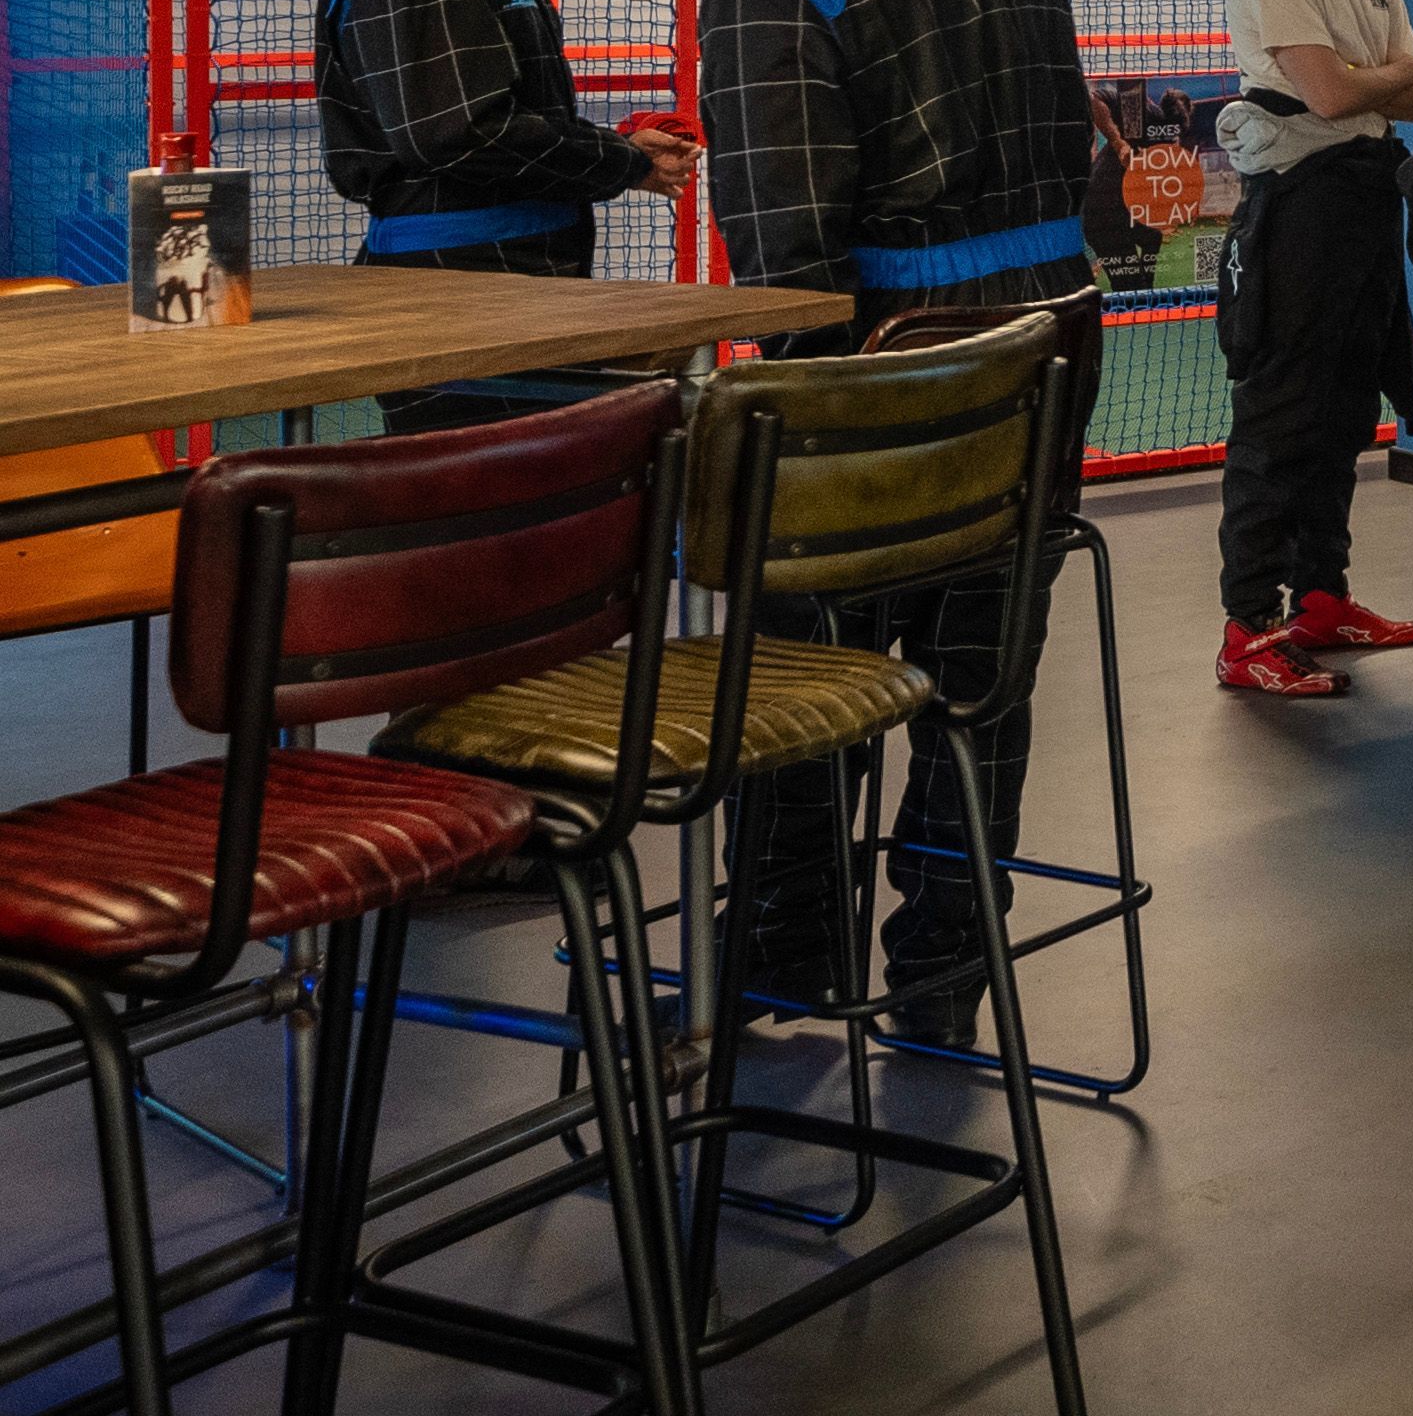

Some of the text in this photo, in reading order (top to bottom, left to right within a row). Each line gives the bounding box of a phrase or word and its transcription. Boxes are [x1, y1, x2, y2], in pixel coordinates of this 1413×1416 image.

[1146, 124, 1181, 137] SIXES
[1130, 145, 1199, 171] HOW
[1146, 176, 1183, 199] TO
[1130, 202, 1198, 228] PLAY
